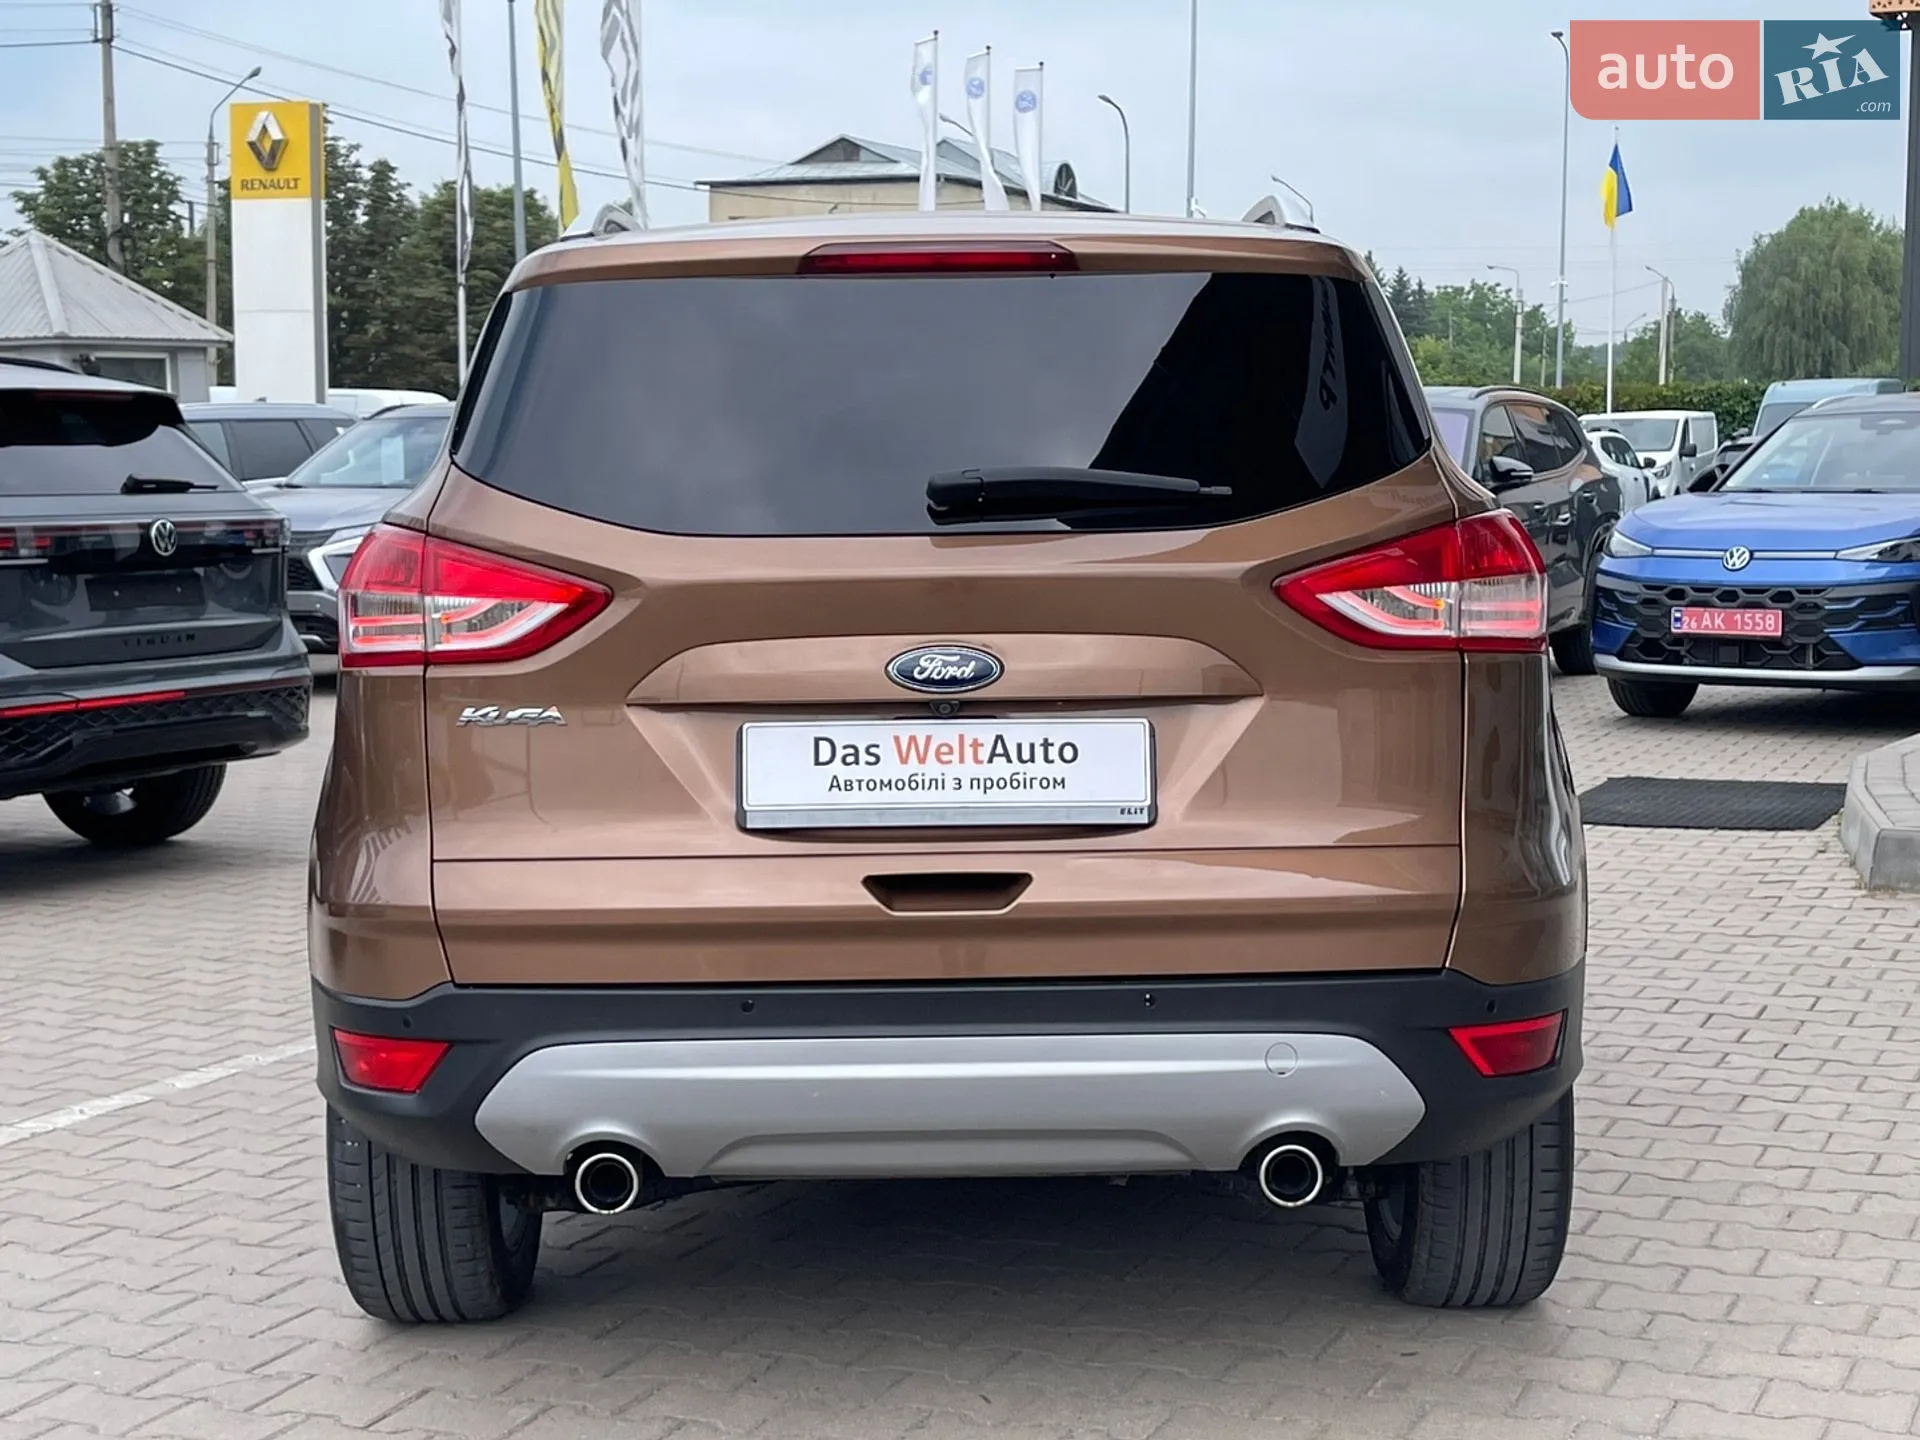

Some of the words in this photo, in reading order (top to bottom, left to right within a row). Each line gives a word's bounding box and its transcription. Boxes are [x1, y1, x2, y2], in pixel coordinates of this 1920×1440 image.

[240, 177, 302, 191] RENAULT
[1682, 615, 1698, 630] 26
[1701, 611, 1726, 630] AK
[1733, 613, 1775, 631] 1558
[913, 654, 976, 680] Ford
[813, 735, 881, 766] Das
[893, 733, 1080, 766] WeltAuto
[828, 773, 946, 792] Автомобілі
[952, 776, 963, 792] з
[969, 772, 1066, 795] пробігом
